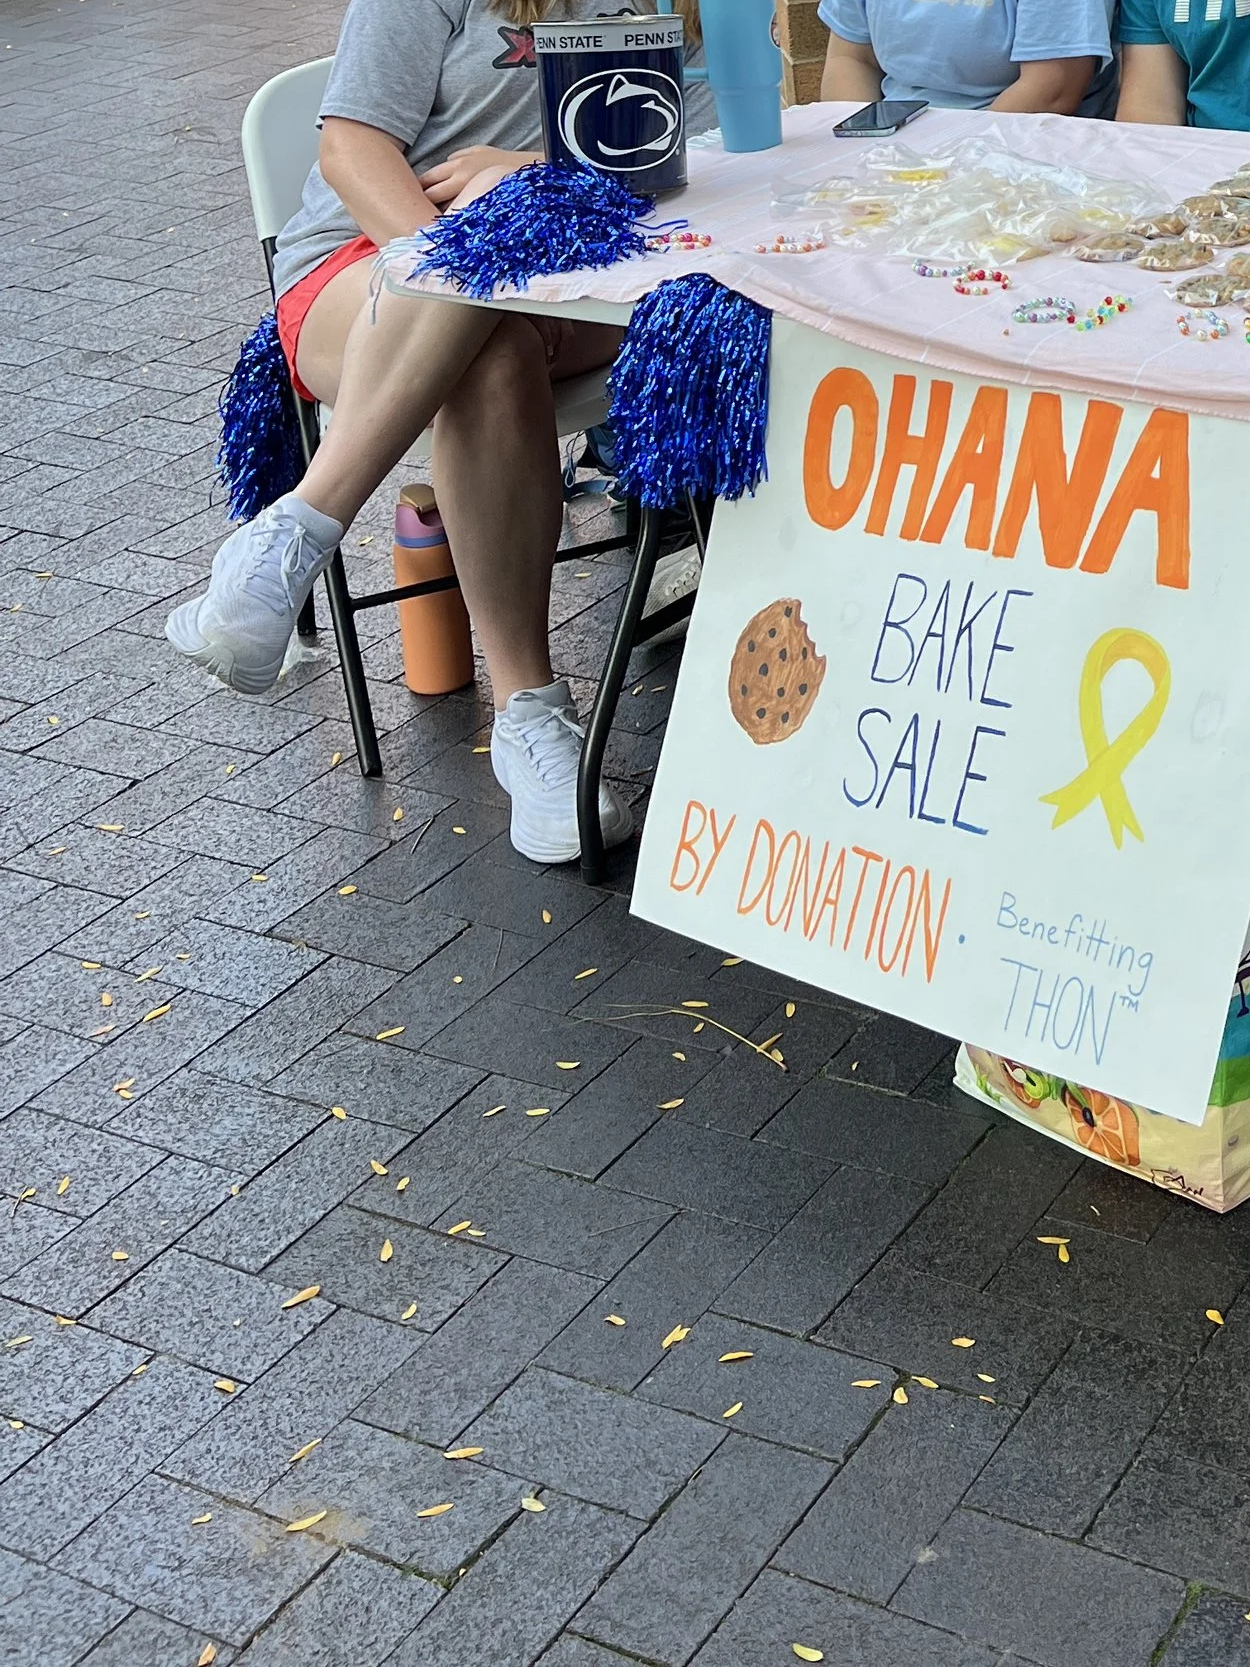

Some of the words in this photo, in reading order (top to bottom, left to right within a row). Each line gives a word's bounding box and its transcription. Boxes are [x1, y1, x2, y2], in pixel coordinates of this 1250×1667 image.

[559, 35, 604, 49] STATE
[624, 32, 665, 47] PENN
[801, 367, 1191, 590] OHANA
[870, 573, 1034, 709] BAKE
[842, 707, 1007, 835] SALE
[669, 800, 737, 896] BY
[996, 891, 1154, 997] Benefitting
